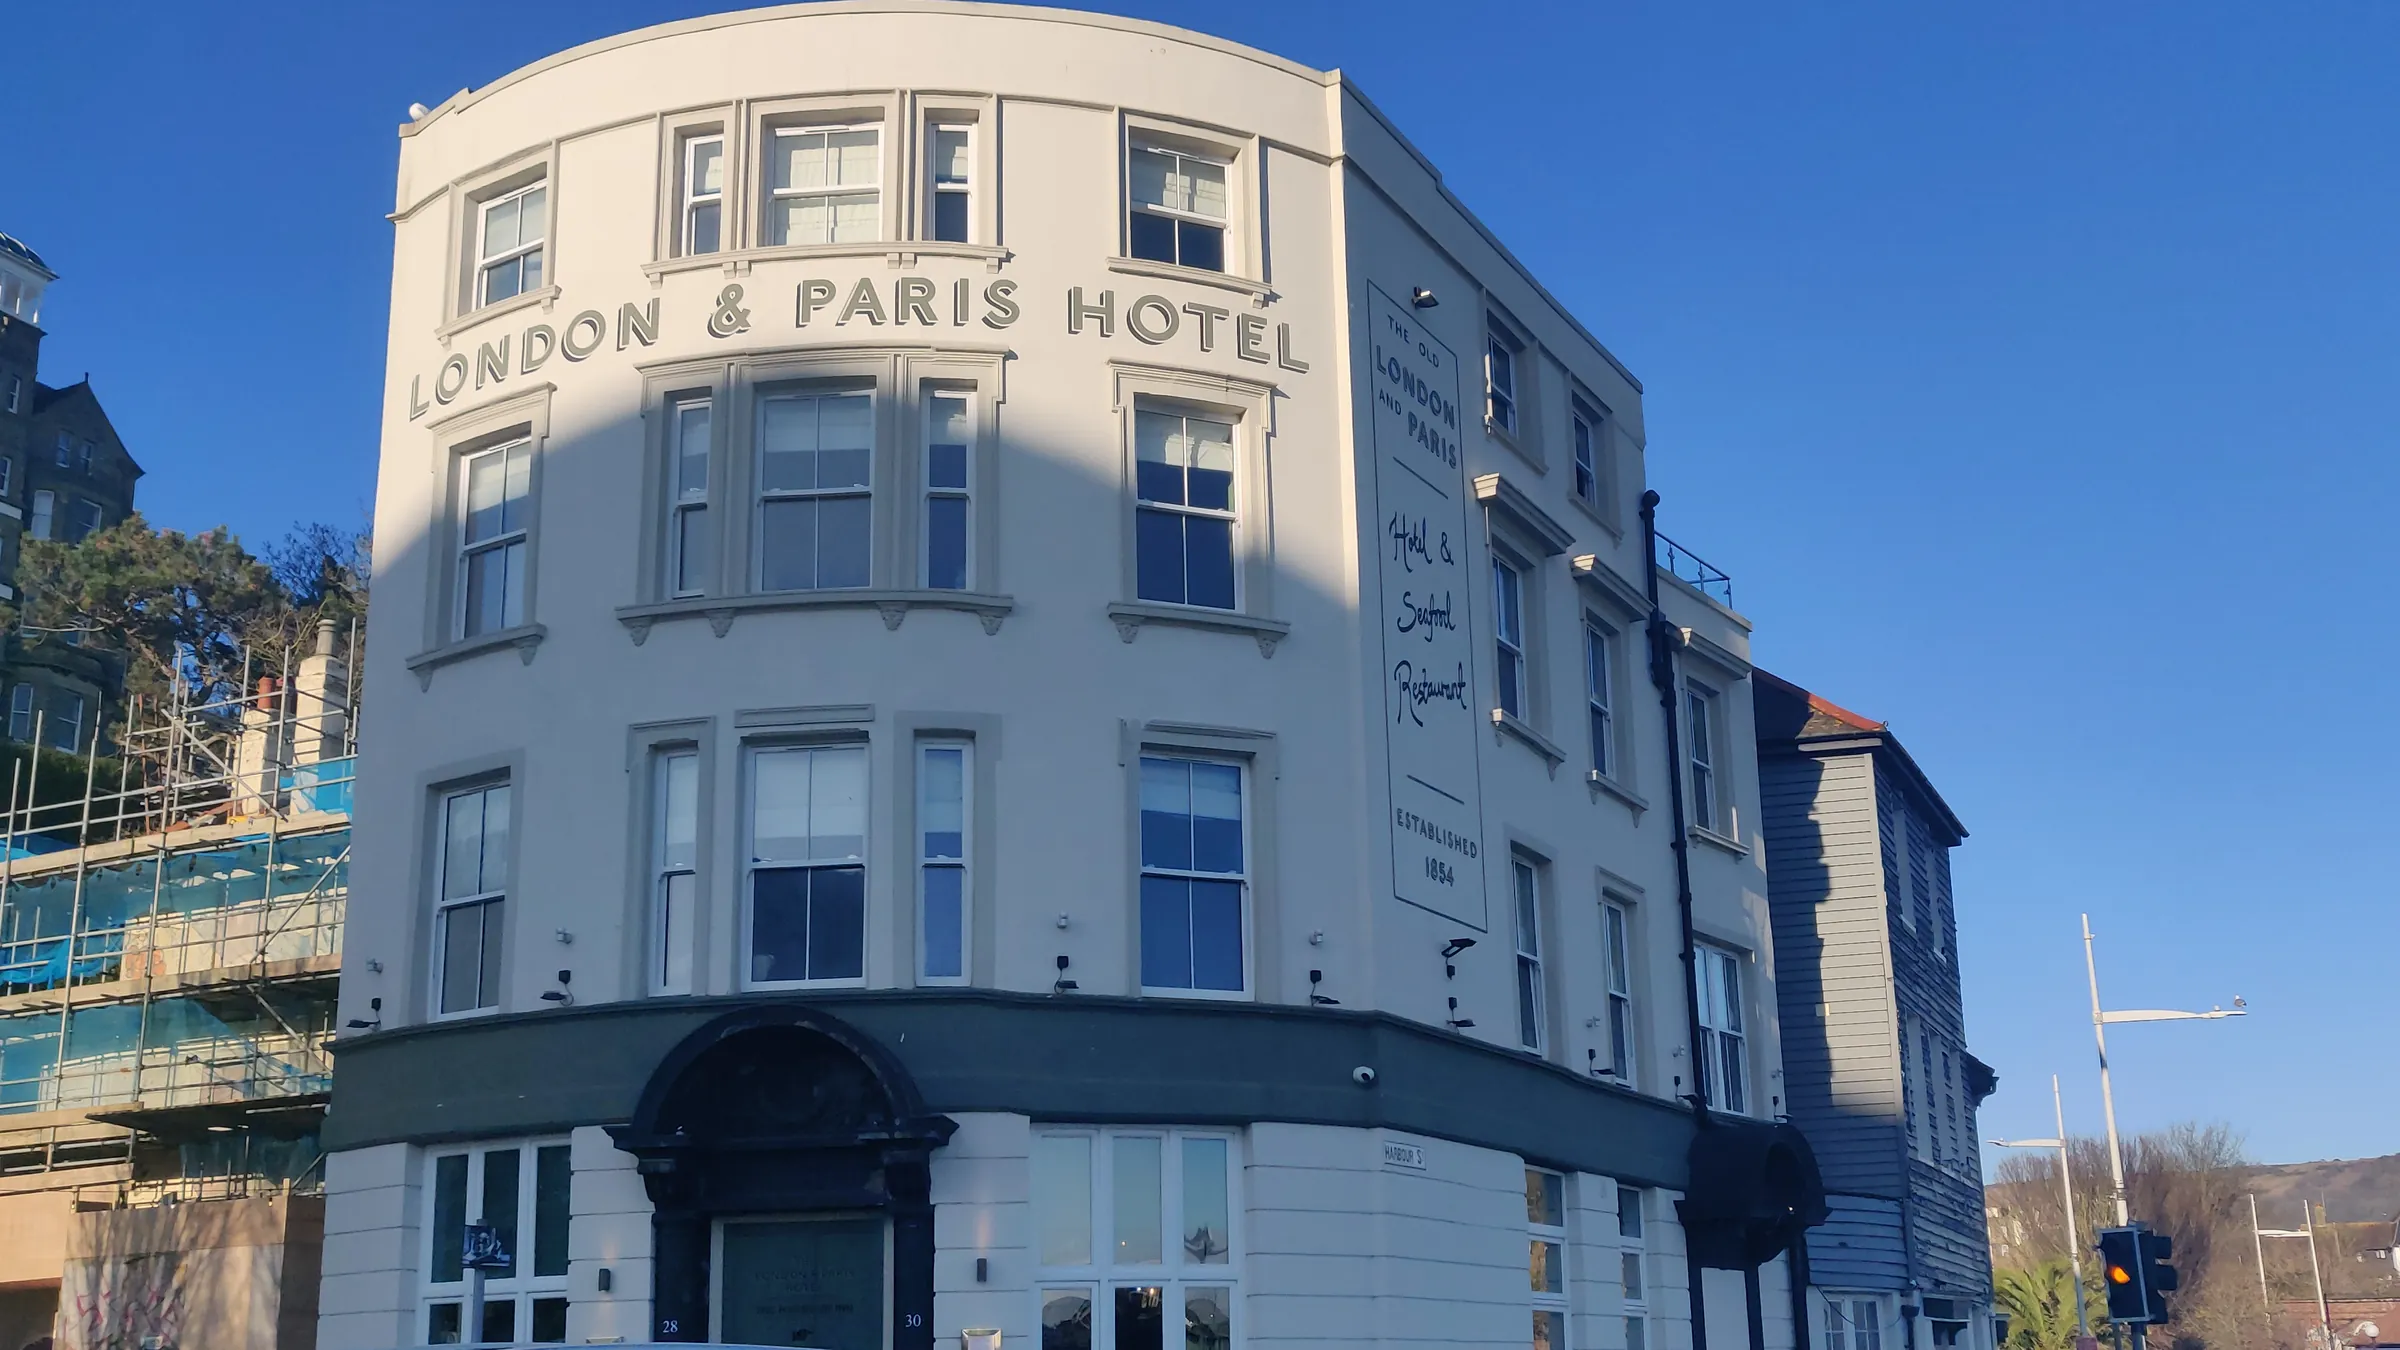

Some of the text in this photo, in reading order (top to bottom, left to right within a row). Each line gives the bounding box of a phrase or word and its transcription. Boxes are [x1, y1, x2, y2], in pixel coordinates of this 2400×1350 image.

[409, 277, 1310, 422] LONDON & PARIS HOTEL
[1387, 313, 1439, 368] THE OLD
[1376, 345, 1455, 430] LONDON
[1379, 388, 1457, 469] AND PARIS
[1389, 511, 1454, 573] Hotel &
[1397, 591, 1456, 642] Seafood
[1394, 659, 1467, 727] Restaurant
[1396, 807, 1478, 859] ESTABLISHED
[1425, 856, 1455, 887] 1854
[662, 1320, 678, 1334] 28
[905, 1314, 922, 1328] 30
